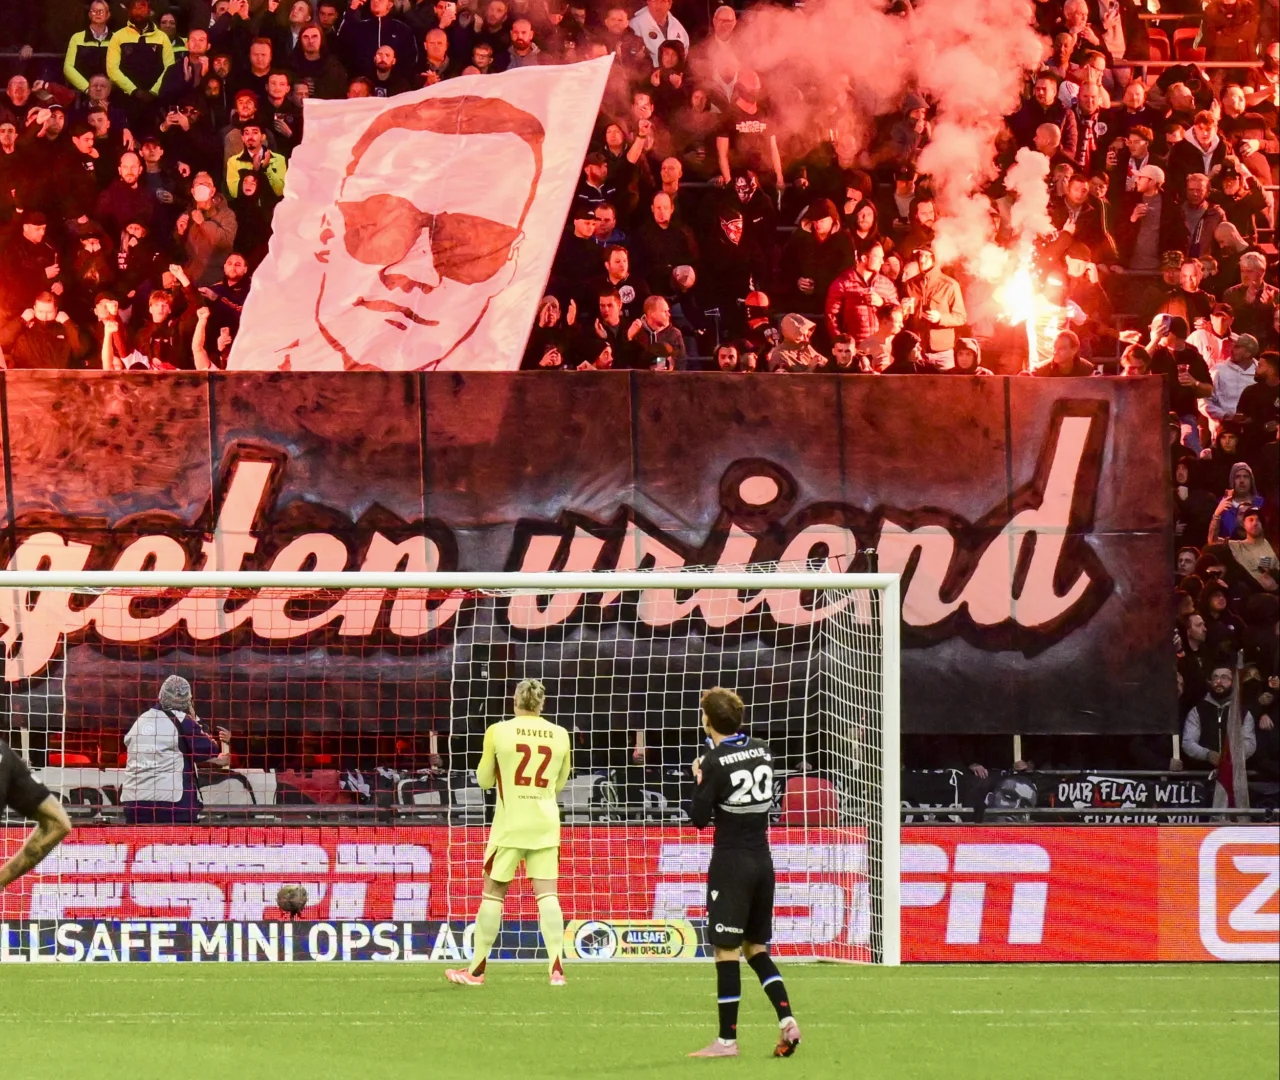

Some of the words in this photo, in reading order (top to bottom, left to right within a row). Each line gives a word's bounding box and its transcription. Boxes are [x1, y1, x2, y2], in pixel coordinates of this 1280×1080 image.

[508, 416, 1095, 636] vriend
[514, 743, 552, 788] 22
[730, 764, 774, 803] 20
[1100, 780, 1148, 803] FLAG
[1155, 783, 1201, 804] WILL
[192, 923, 292, 961] MINI
[621, 946, 639, 955] MINI
[640, 946, 672, 955] OPSLAG
[626, 930, 667, 943] ALLSAFE
